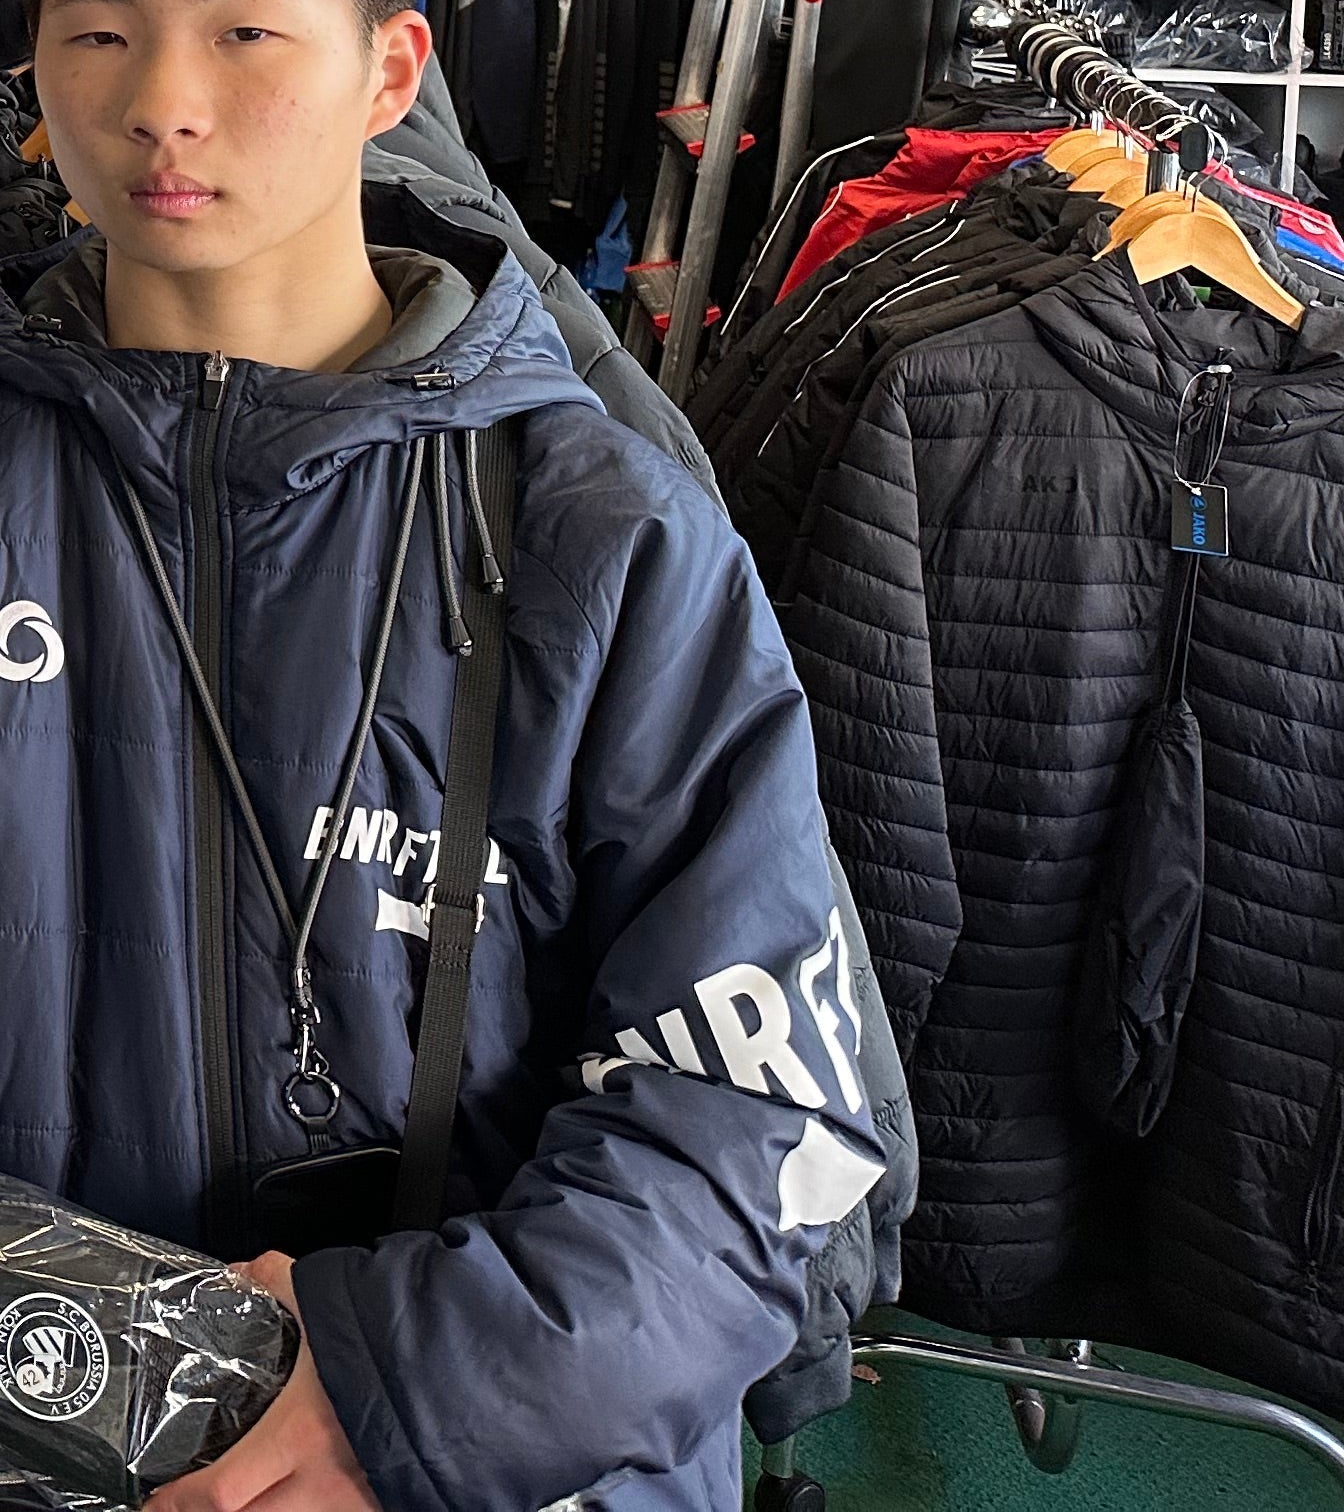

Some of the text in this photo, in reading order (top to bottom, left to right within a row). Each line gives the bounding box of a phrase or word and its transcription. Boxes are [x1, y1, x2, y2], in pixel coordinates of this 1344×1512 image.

[1191, 512, 1206, 545] JAKO
[79, 1321, 103, 1391] BORUSSIA
[22, 1369, 40, 1387] 42
[73, 1391, 90, 1408] 05
